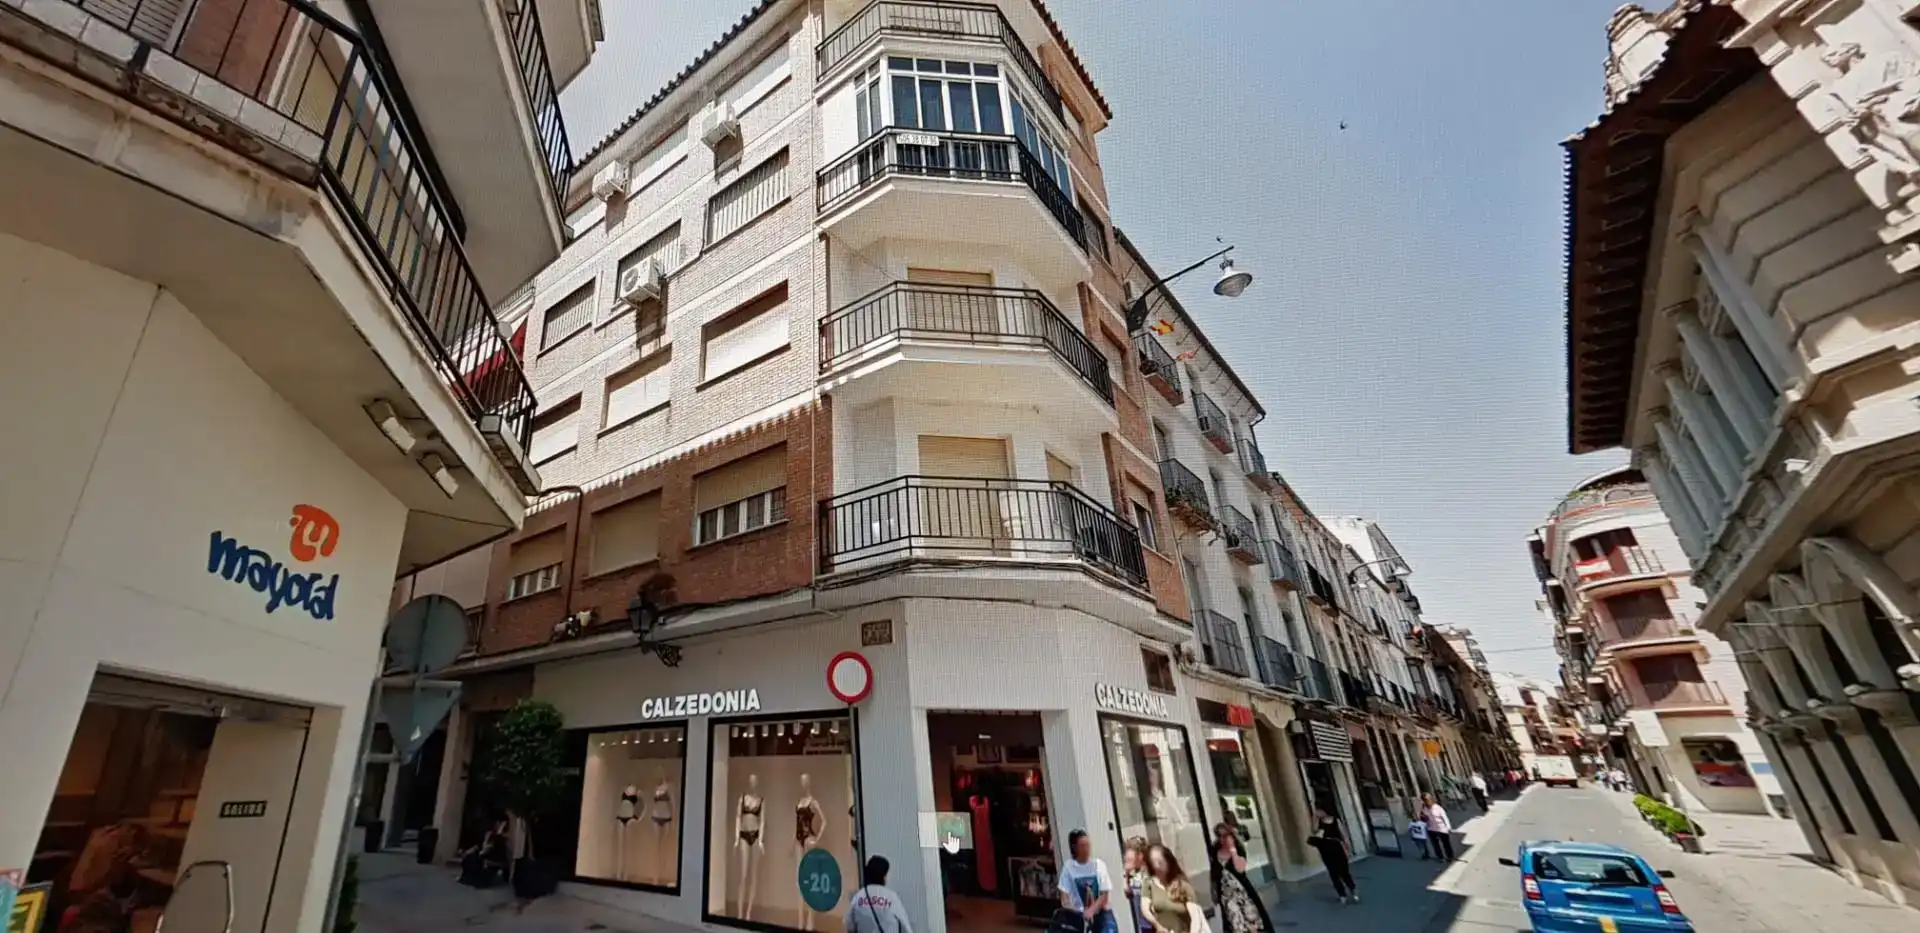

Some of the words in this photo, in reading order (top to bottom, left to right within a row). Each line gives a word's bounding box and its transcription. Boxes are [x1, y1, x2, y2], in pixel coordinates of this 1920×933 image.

[207, 530, 340, 620] mayoral
[641, 688, 761, 719] CALZEDONIA
[1095, 682, 1168, 718] CALZEDONIA
[223, 803, 263, 815] SALIDA
[858, 895, 892, 908] BOSCH
